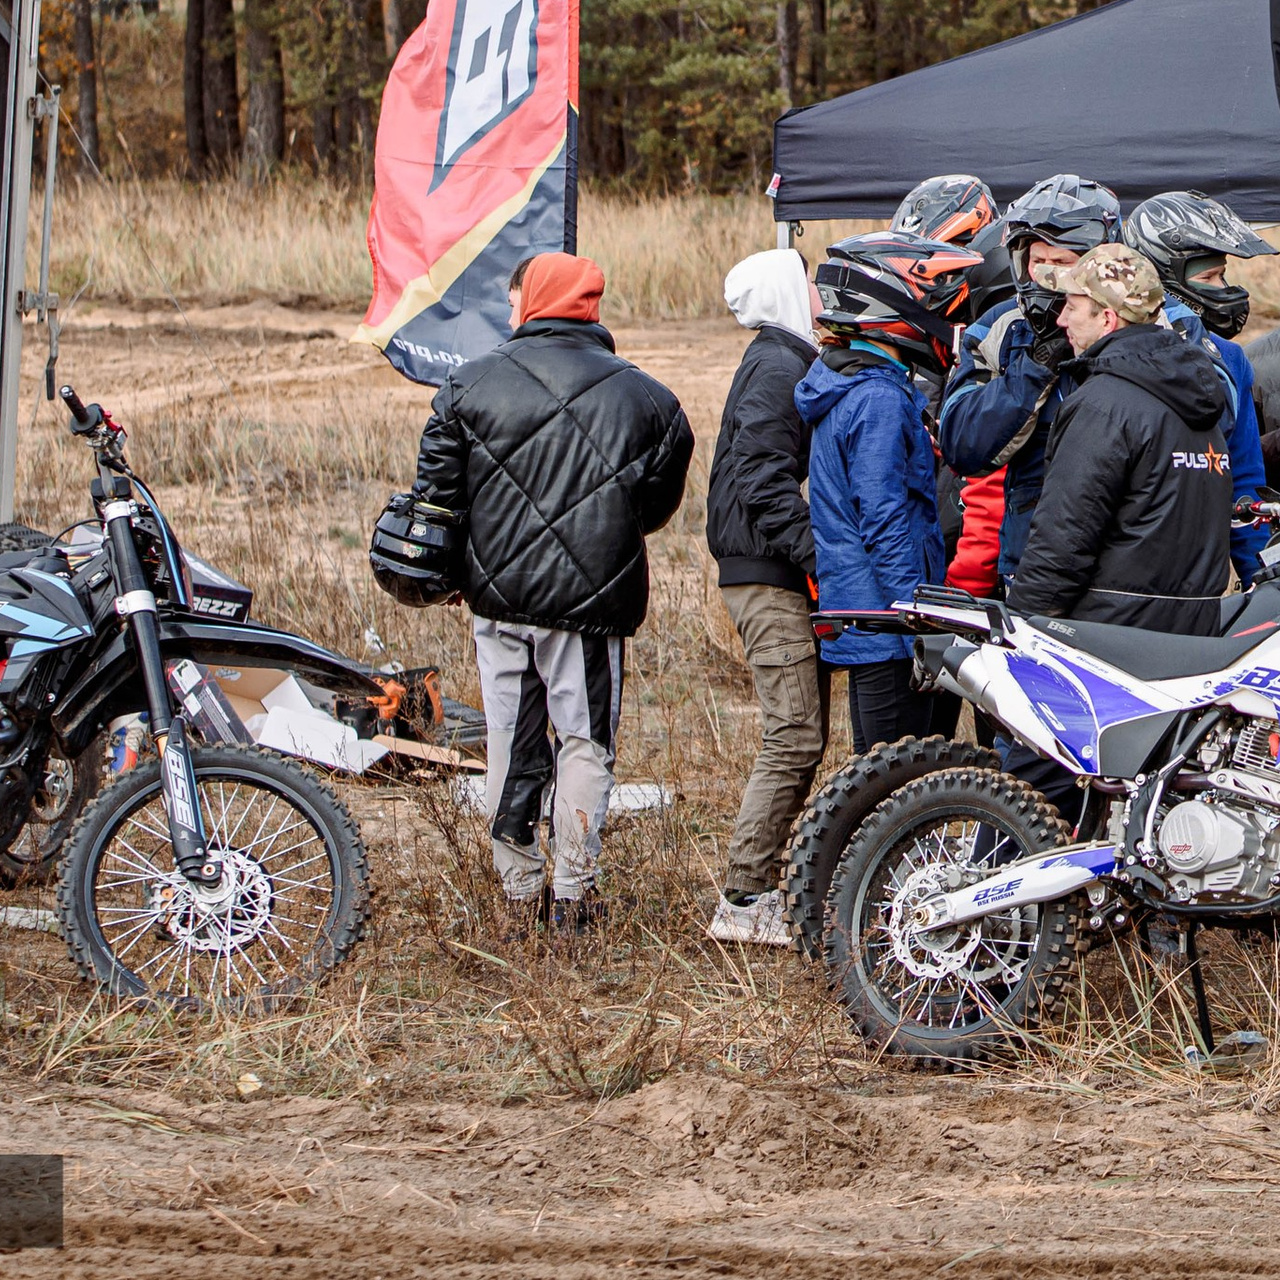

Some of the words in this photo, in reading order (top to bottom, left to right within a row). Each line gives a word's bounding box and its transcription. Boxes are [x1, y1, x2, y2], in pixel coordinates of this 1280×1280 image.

[1047, 621, 1077, 637] BSE
[166, 747, 195, 830] BSE
[972, 878, 1024, 902] BSE
[991, 891, 1015, 902] RUSSIA
